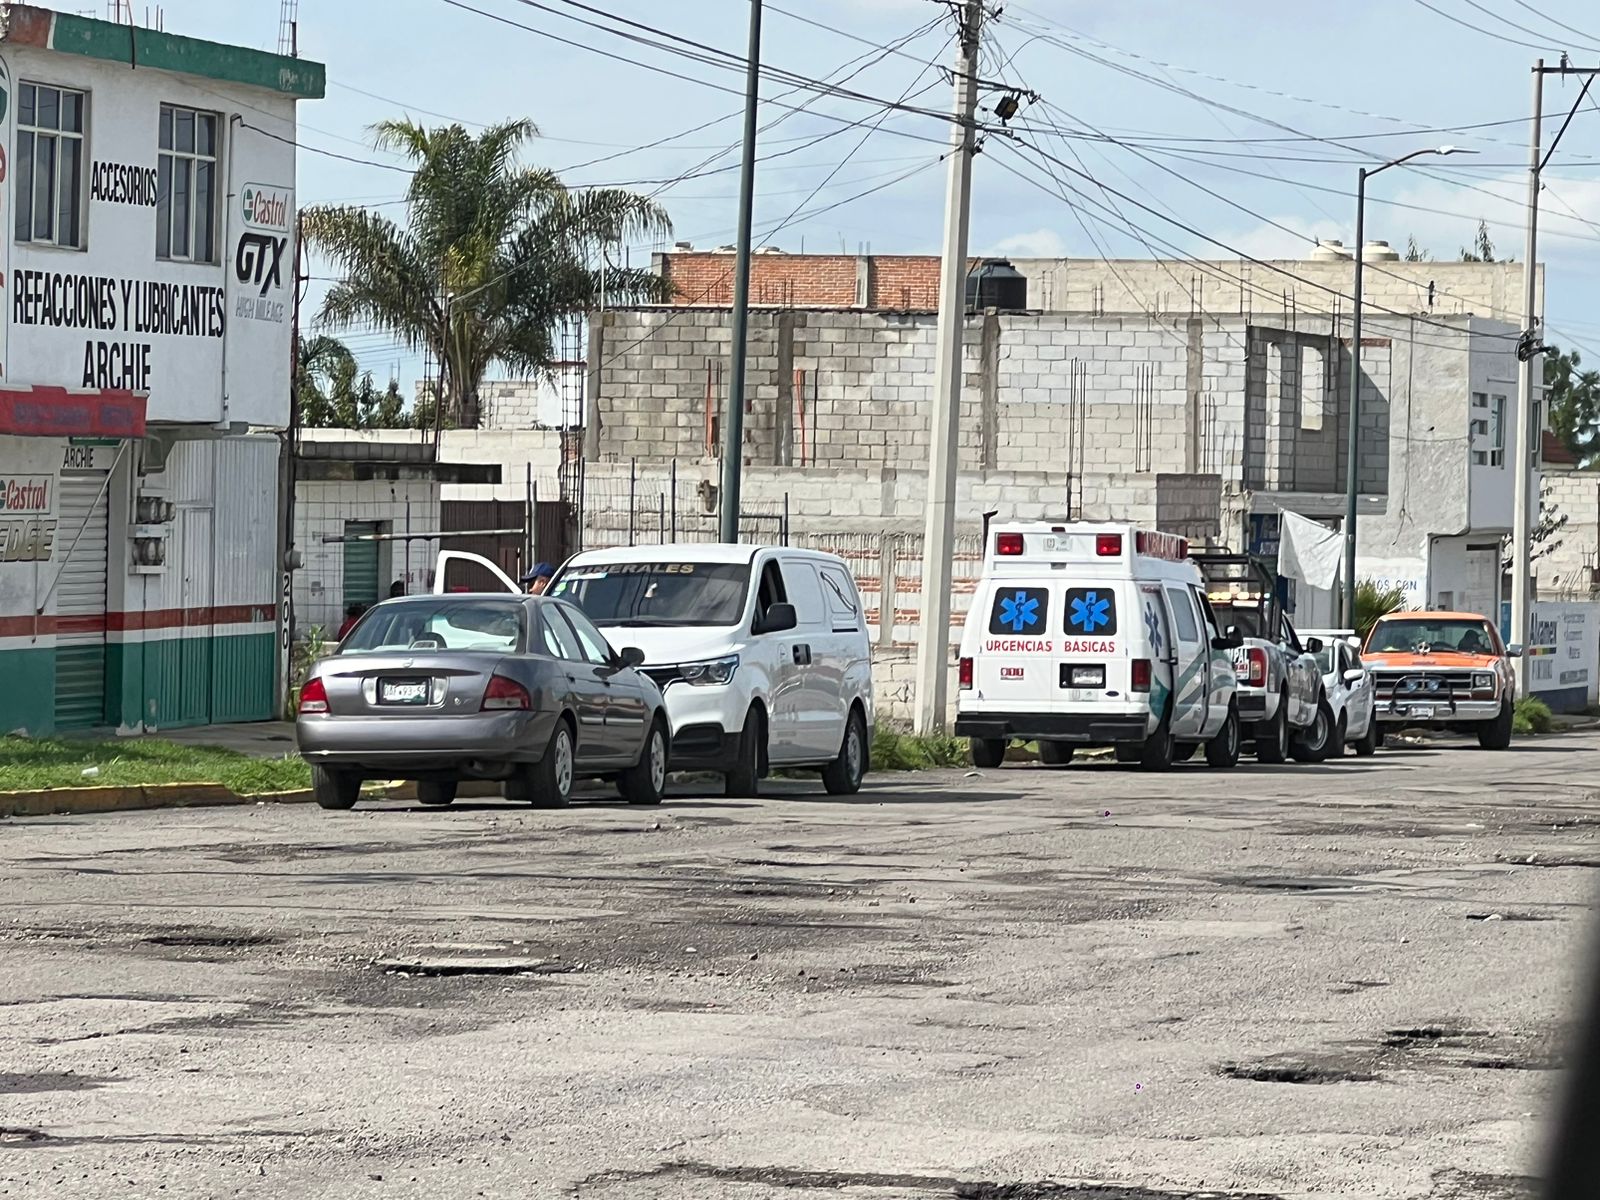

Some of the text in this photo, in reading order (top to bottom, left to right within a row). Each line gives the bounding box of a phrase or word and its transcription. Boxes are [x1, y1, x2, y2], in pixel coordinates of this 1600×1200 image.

[91, 161, 157, 207] ACCESORIOS
[253, 190, 288, 227] Castrol
[236, 232, 288, 297] GTX
[13, 269, 224, 338] REFACCIONES Y LUBRICANTES
[82, 340, 152, 391] ARCHIE
[63, 448, 94, 468] ARCHIE
[6, 479, 48, 510] Castrol
[282, 574, 290, 650] 200
[986, 640, 1052, 652] URGENCIAS
